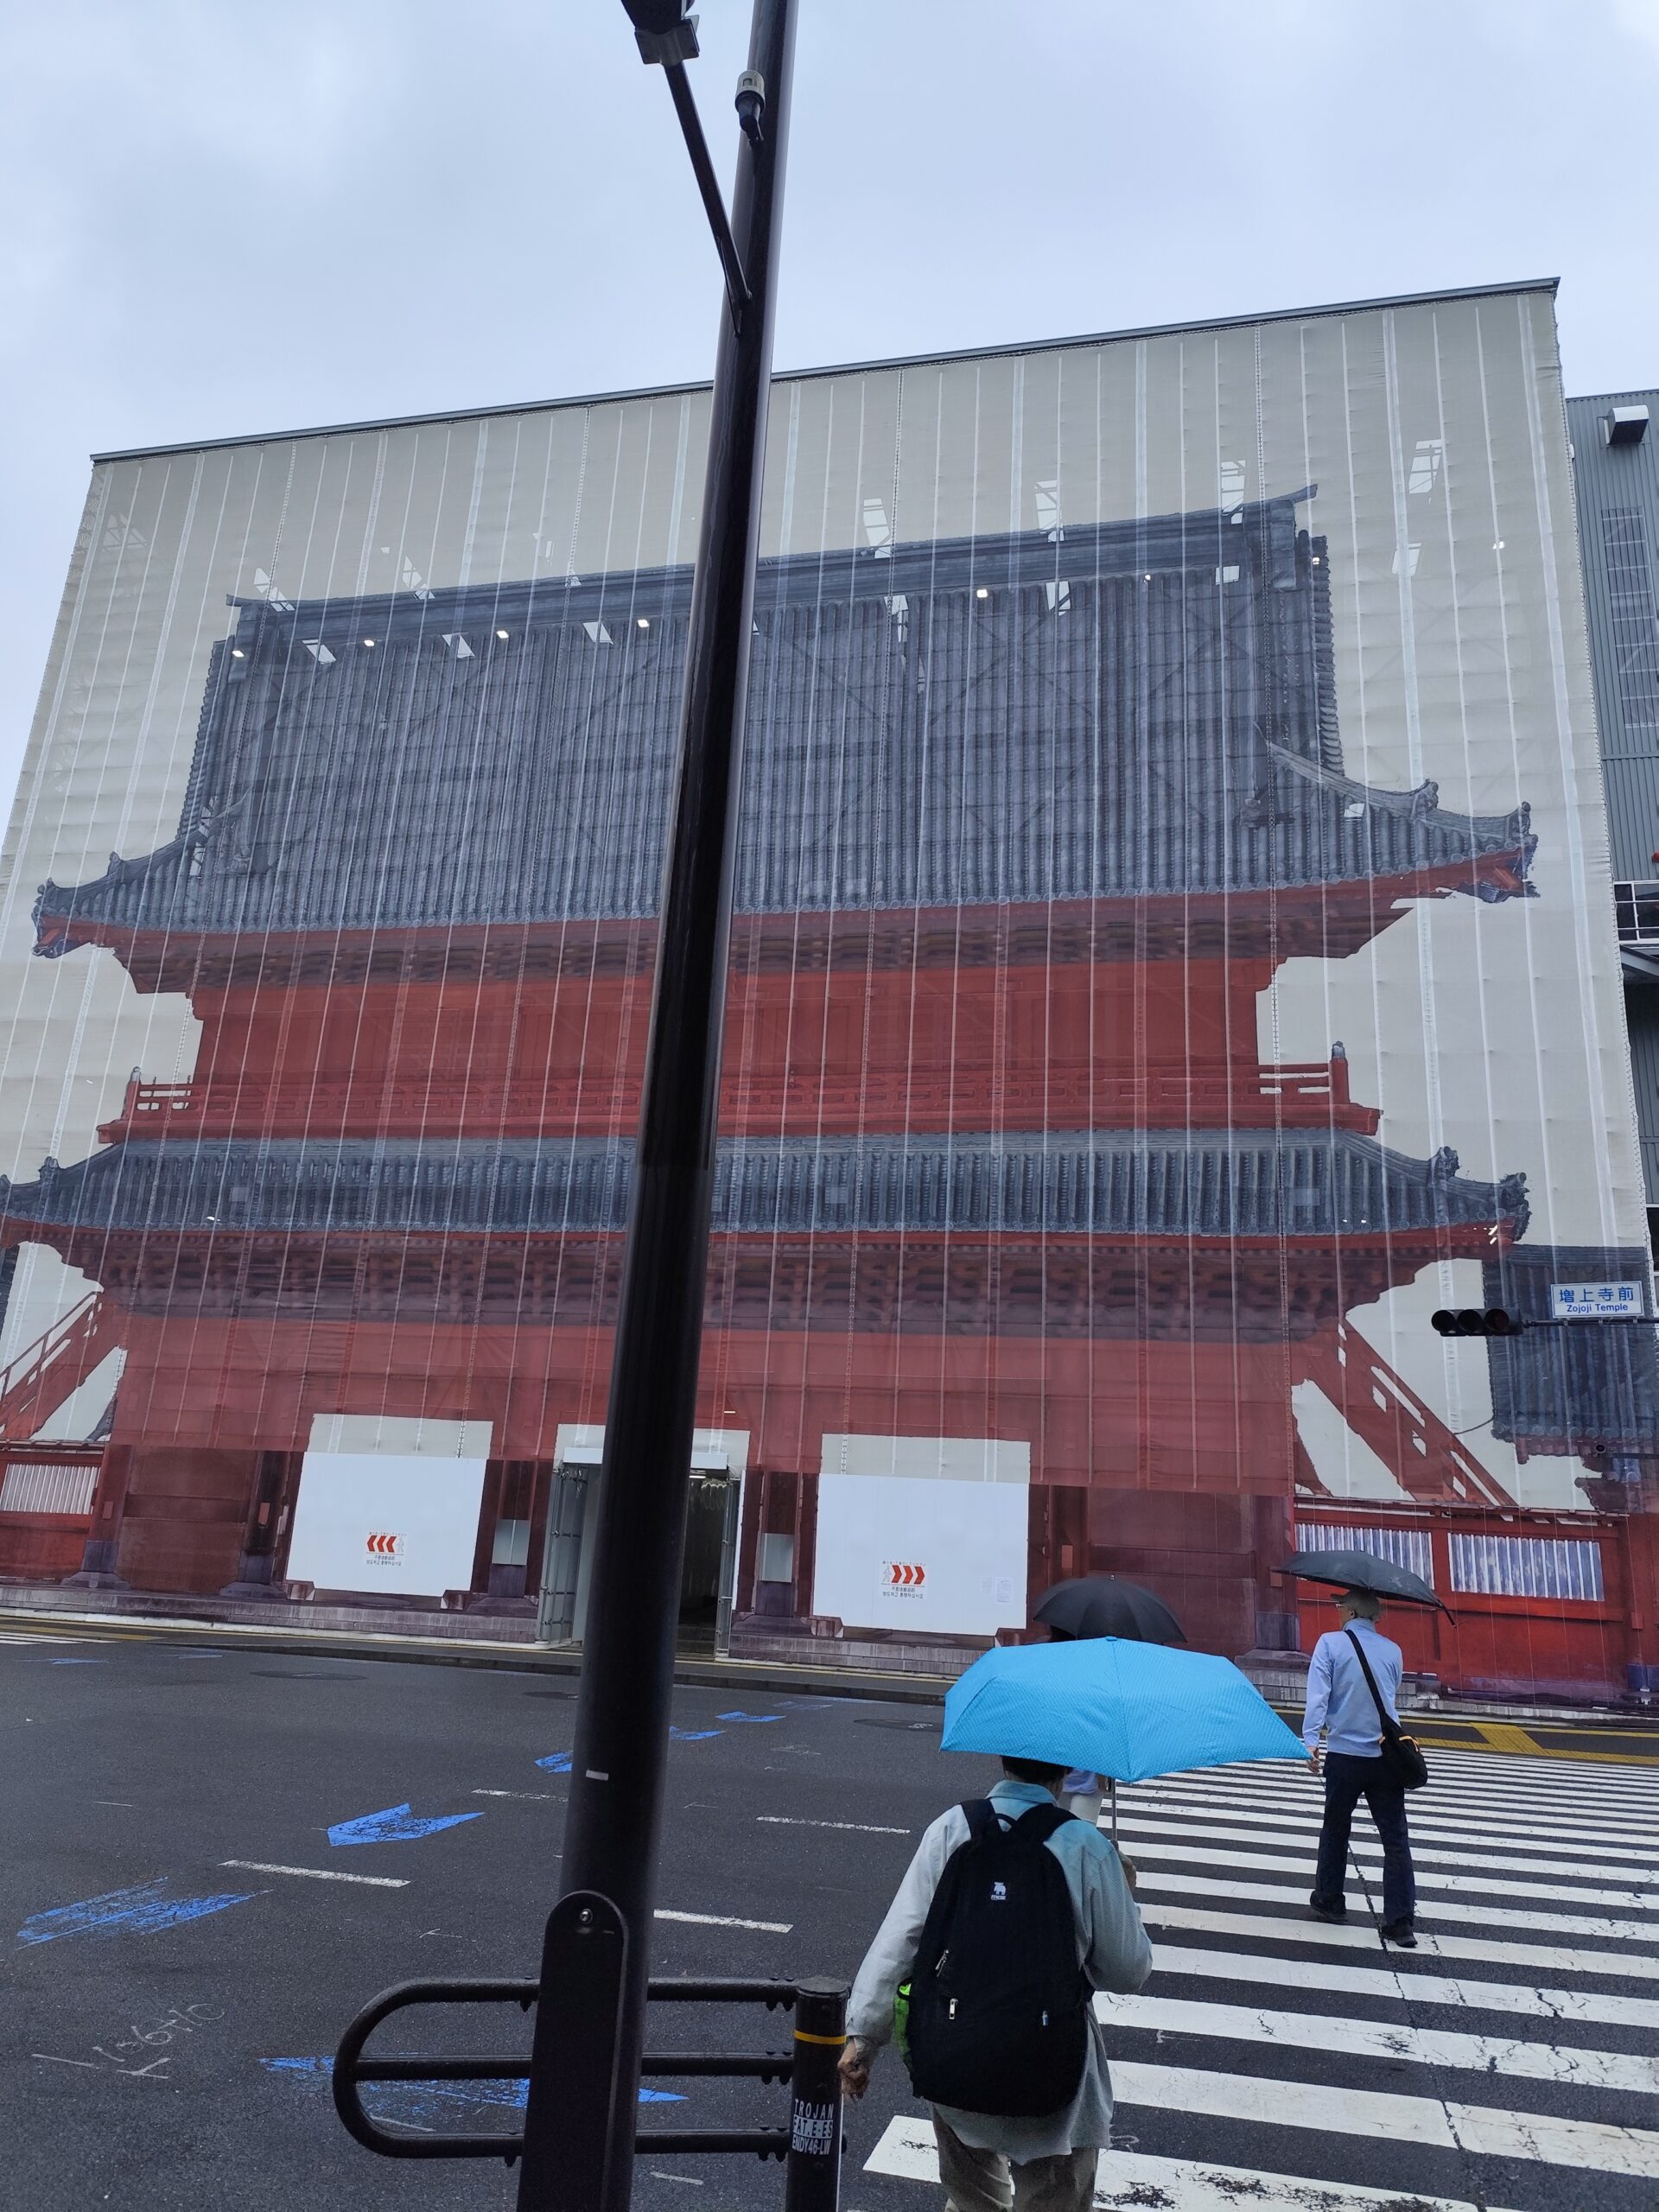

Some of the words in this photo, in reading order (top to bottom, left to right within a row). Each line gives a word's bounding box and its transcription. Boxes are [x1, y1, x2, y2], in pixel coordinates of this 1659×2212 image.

[1559, 1286, 1634, 1303] 増上寺前
[1567, 1304, 1592, 1313] Zojoji
[1595, 1303, 1629, 1313] Temple
[795, 2098, 834, 2120] TROJAN
